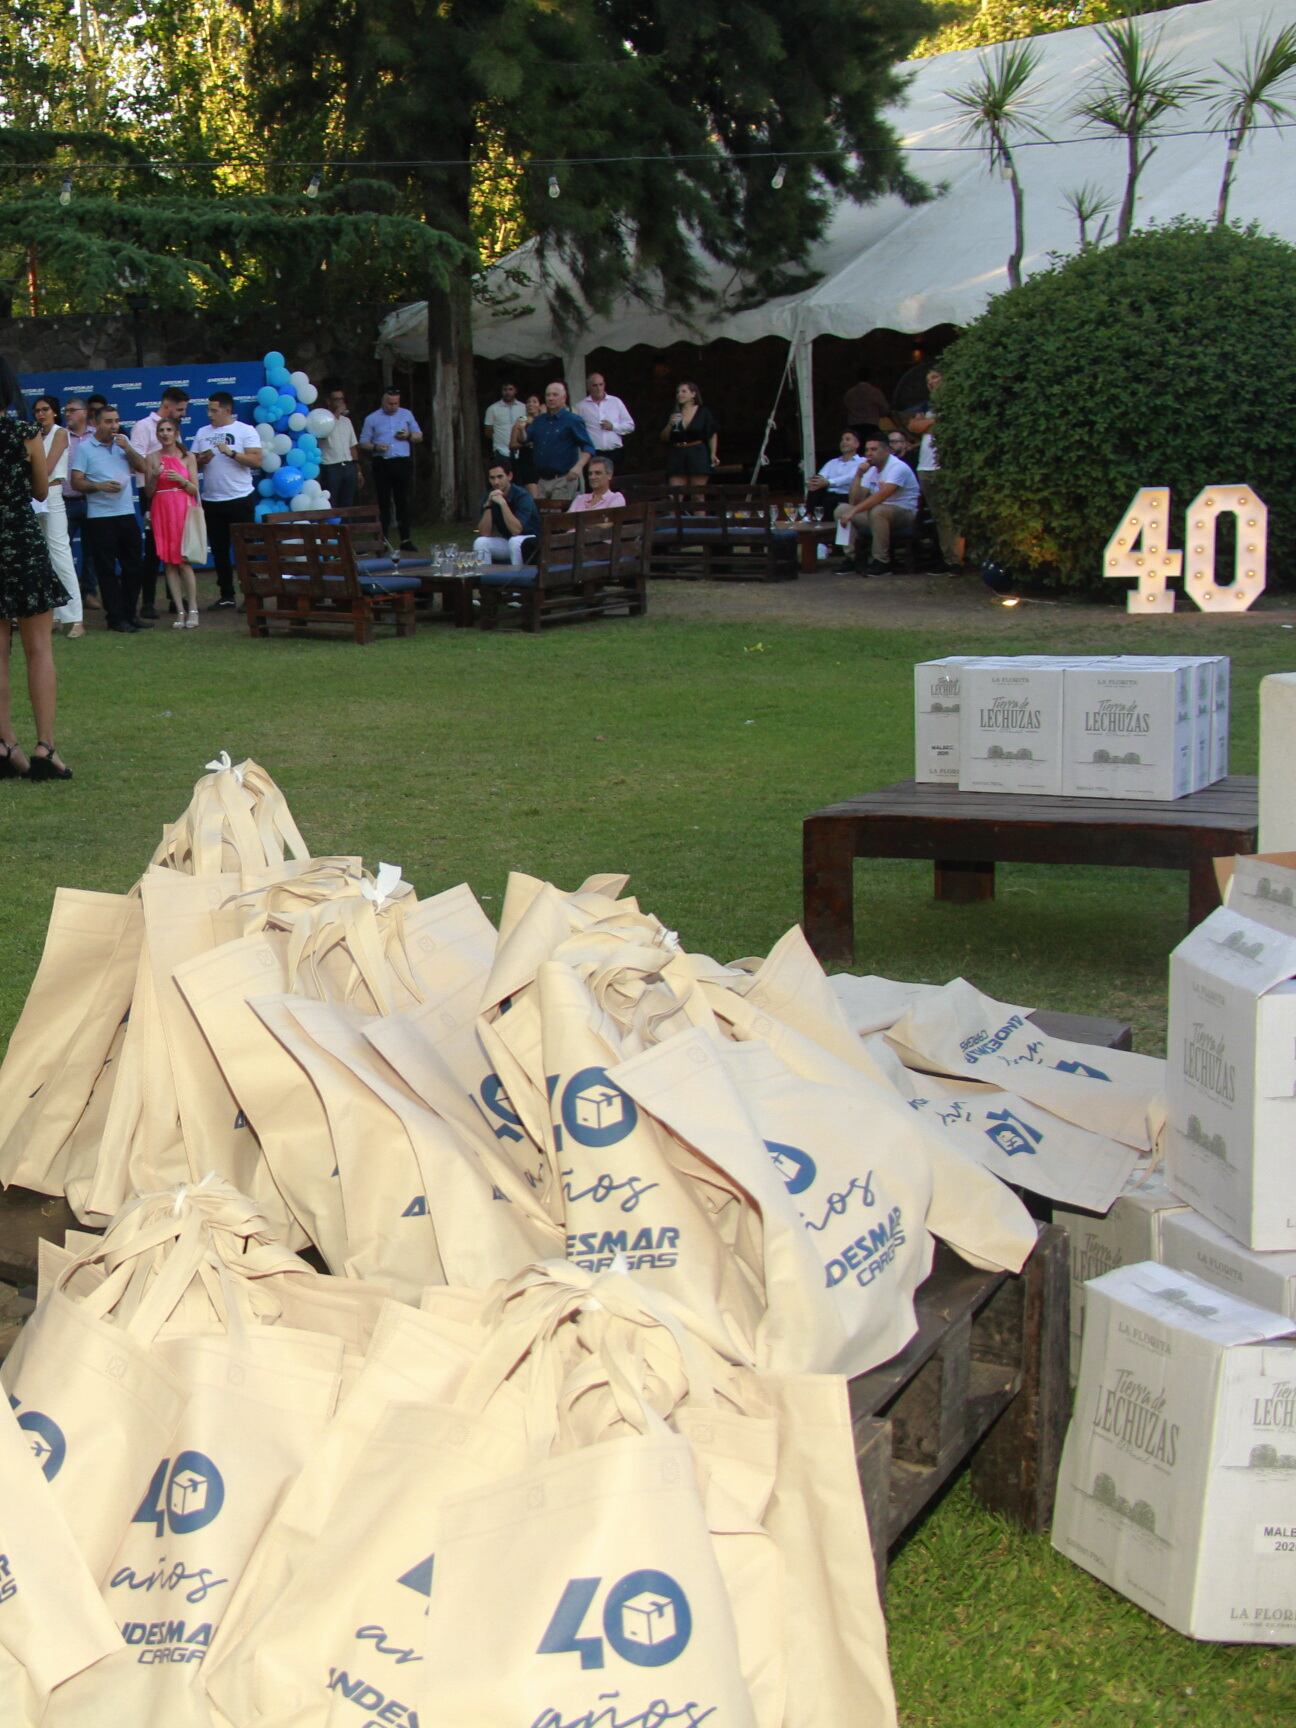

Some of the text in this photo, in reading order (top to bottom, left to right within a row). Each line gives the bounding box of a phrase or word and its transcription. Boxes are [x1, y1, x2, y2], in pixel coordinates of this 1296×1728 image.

[1103, 484, 1268, 613] 40
[979, 708, 1041, 729] LECHUZAS
[1084, 711, 1150, 733] LECHUZAS
[1183, 1037, 1236, 1103] LECHUZAS
[565, 1226, 681, 1257] ESMAR
[1118, 1321, 1131, 1337] LA
[1115, 1368, 1167, 1413] Tierra de
[1093, 1384, 1180, 1467] LECHUZAS
[130, 1449, 226, 1538] 40
[1263, 1526, 1296, 1538] MALB
[1274, 1541, 1296, 1552] 202
[535, 1567, 693, 1670] 40
[1230, 1607, 1296, 1621] LA FLOR
[137, 1647, 206, 1665] CARGA
